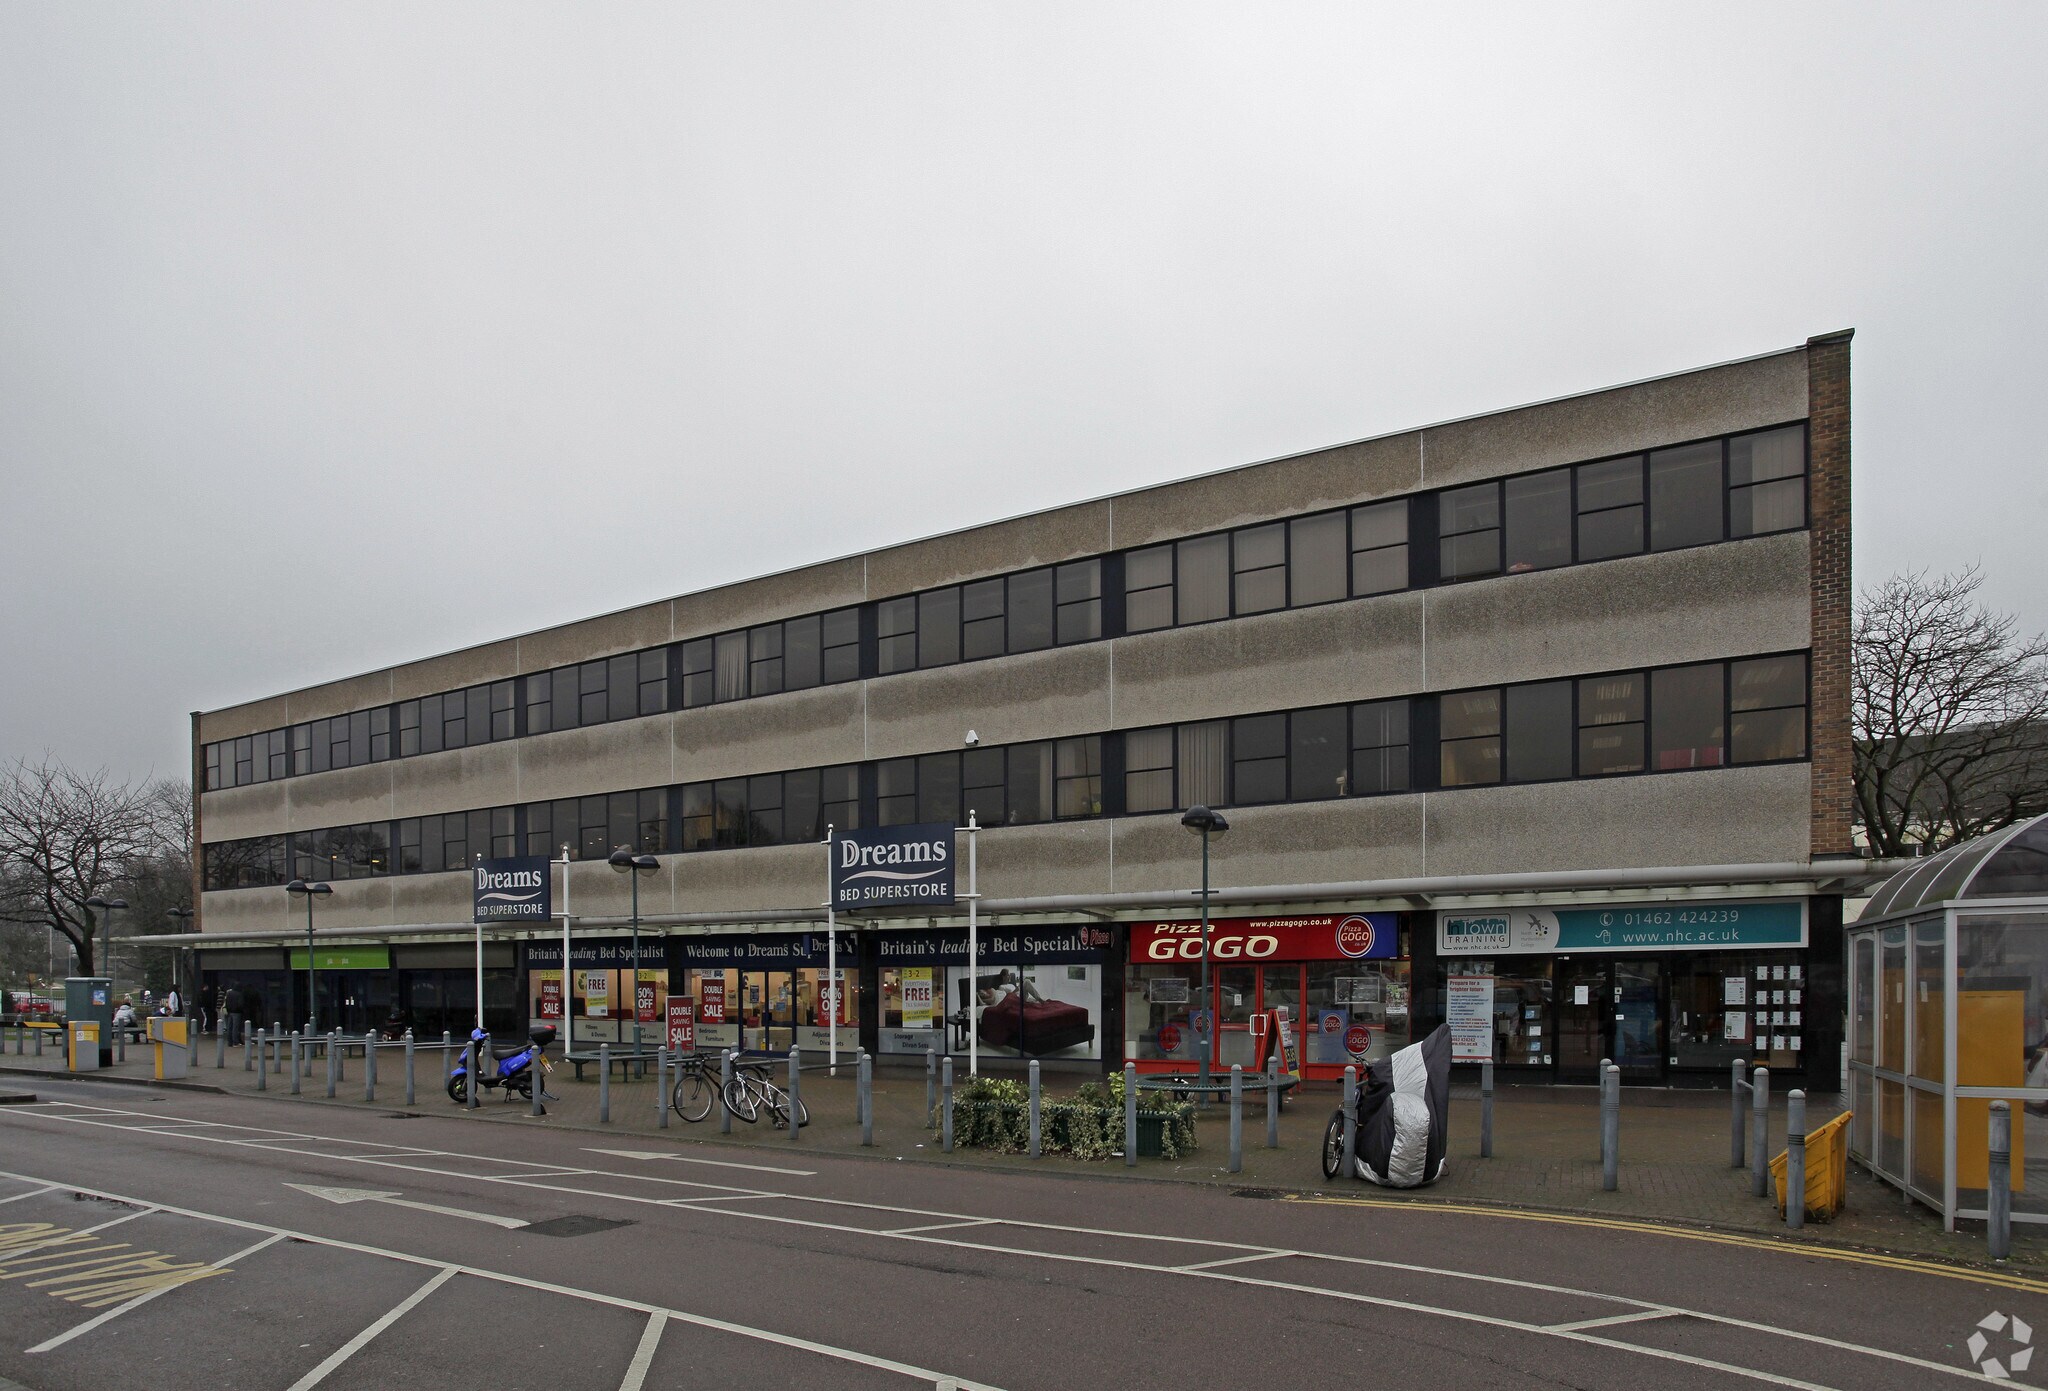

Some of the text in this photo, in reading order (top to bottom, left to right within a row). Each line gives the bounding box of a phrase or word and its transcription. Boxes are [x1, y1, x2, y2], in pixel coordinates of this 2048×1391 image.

[841, 839, 947, 868] Dreams
[477, 867, 542, 890] Dreams
[840, 883, 948, 901] BED SUPERSTORE
[477, 903, 543, 916] BED SUPERSTORE
[1250, 918, 1332, 928] www.pizzagogo.co.uk
[1624, 910, 1739, 926] 01462 424239
[1154, 924, 1215, 934] Pizza
[1622, 928, 1739, 943] www.nhc.ac.uk
[1340, 932, 1370, 941] GOGO
[1448, 935, 1505, 943] TRAINING
[686, 944, 730, 958] Welcome
[733, 946, 744, 957] to
[812, 938, 843, 953] Drems
[880, 941, 935, 955] Britain's
[940, 938, 987, 956] leadig
[993, 937, 1018, 952] Bed
[1148, 935, 1279, 960] GOGO
[528, 948, 564, 960] Britain's
[566, 947, 597, 961] eading
[600, 946, 616, 959] Bed
[543, 985, 559, 994] DOUBLE
[588, 979, 606, 990] FREE
[704, 986, 723, 994] DOUBLE
[638, 987, 654, 998] 60%
[905, 987, 930, 1001] FREE
[543, 1002, 559, 1014] SALE
[638, 998, 653, 1009] OFF
[821, 1000, 840, 1011] OF
[670, 1006, 692, 1016] DOUBLE
[704, 1004, 723, 1017] SALE
[671, 1027, 692, 1042] SALE
[894, 1032, 914, 1041] Storage
